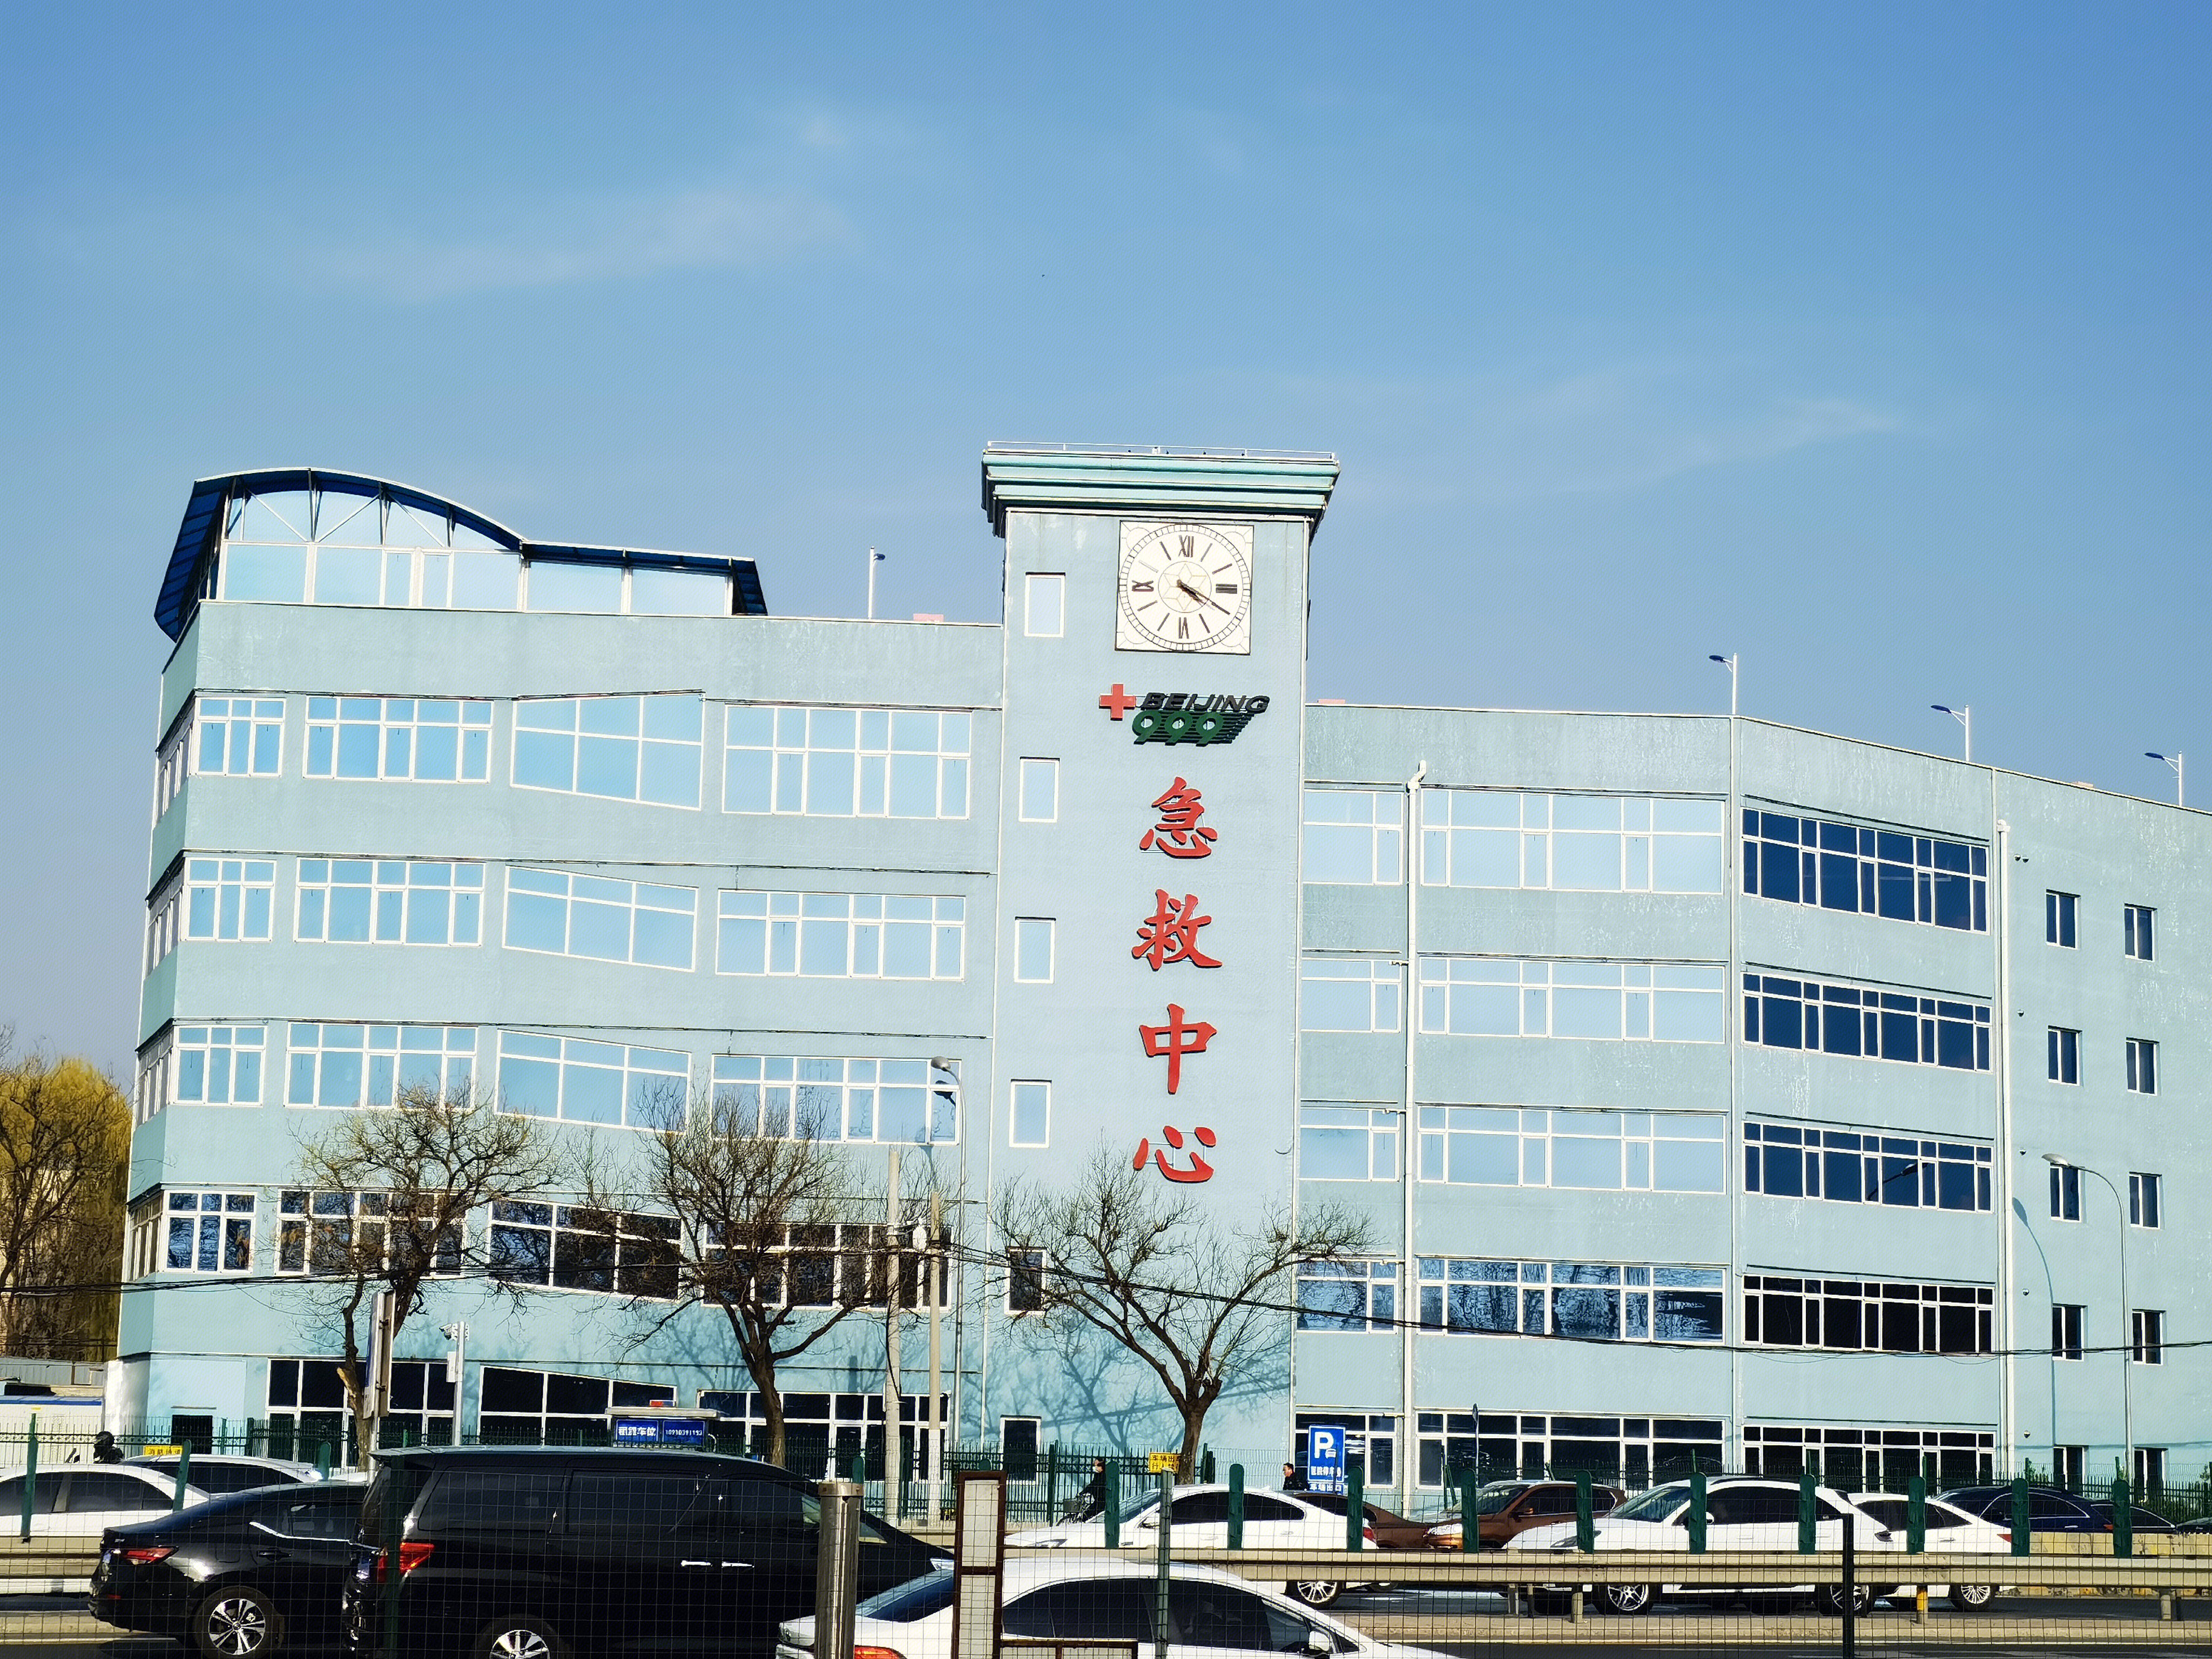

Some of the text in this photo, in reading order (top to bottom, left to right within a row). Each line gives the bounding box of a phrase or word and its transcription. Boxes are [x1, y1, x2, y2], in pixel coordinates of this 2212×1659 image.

[1139, 692, 1270, 714] BEIJING
[1132, 710, 1224, 747] 999
[1132, 777, 1223, 1183] 急救中心
[1314, 1432, 1334, 1459] P
[1309, 1483, 1342, 1492] 车场出口
